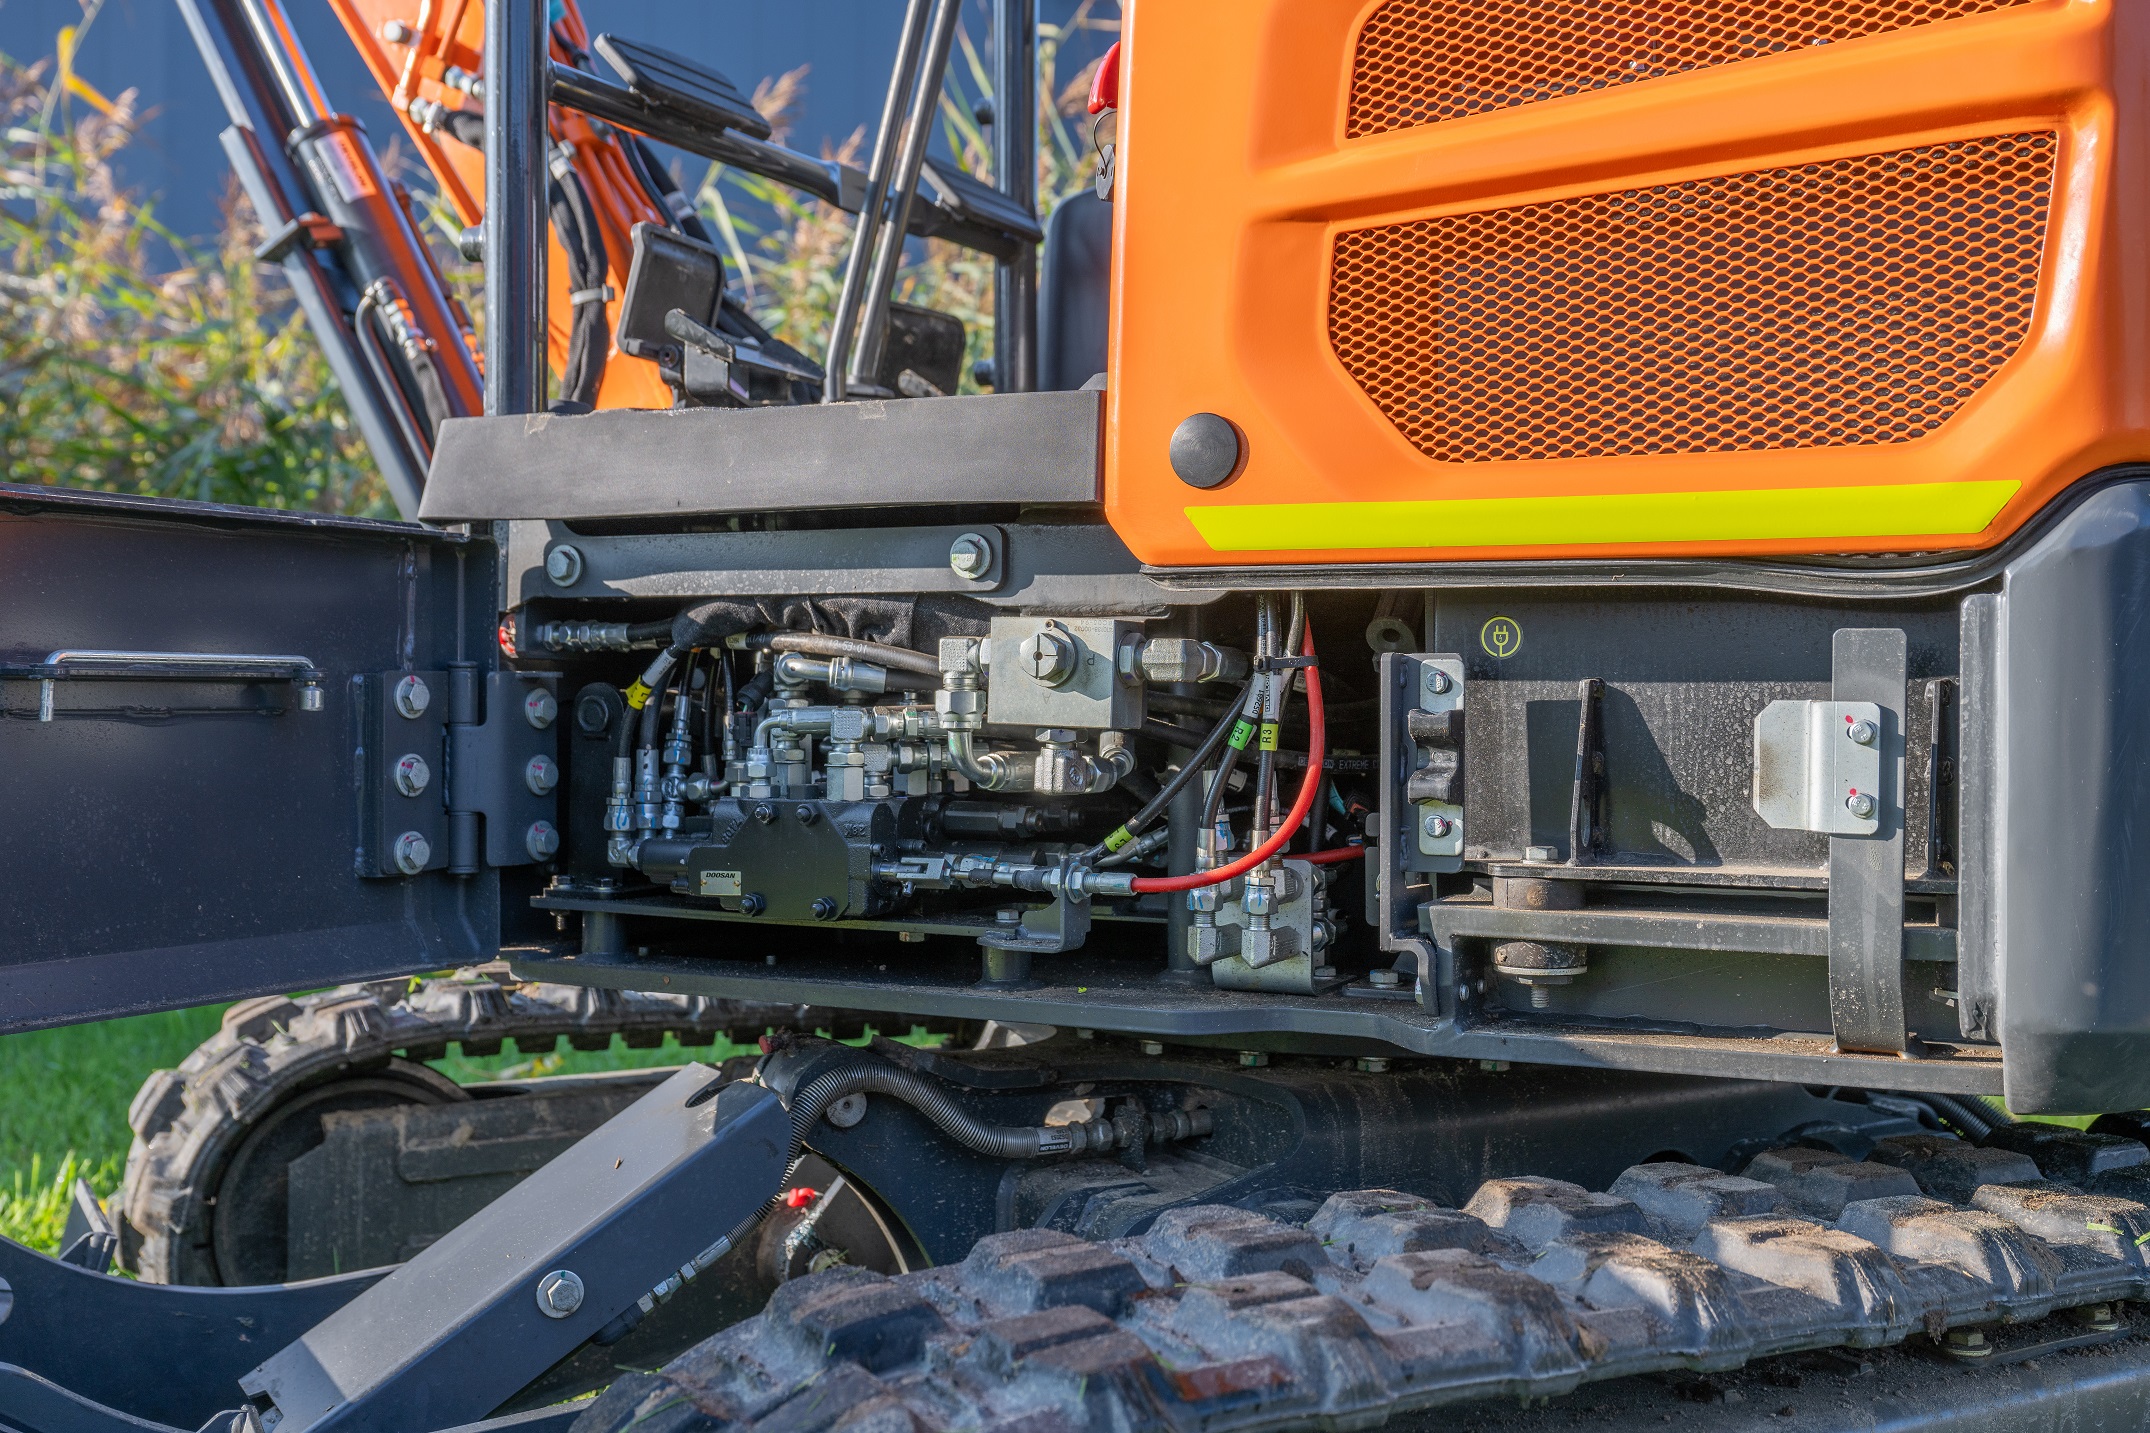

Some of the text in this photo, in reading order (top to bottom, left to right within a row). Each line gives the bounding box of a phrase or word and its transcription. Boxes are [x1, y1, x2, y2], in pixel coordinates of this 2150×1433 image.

[1086, 653, 1096, 666] P
[1232, 726, 1244, 741] R2
[1261, 729, 1272, 744] R3
[1039, 1143, 1068, 1151] DEVELON
